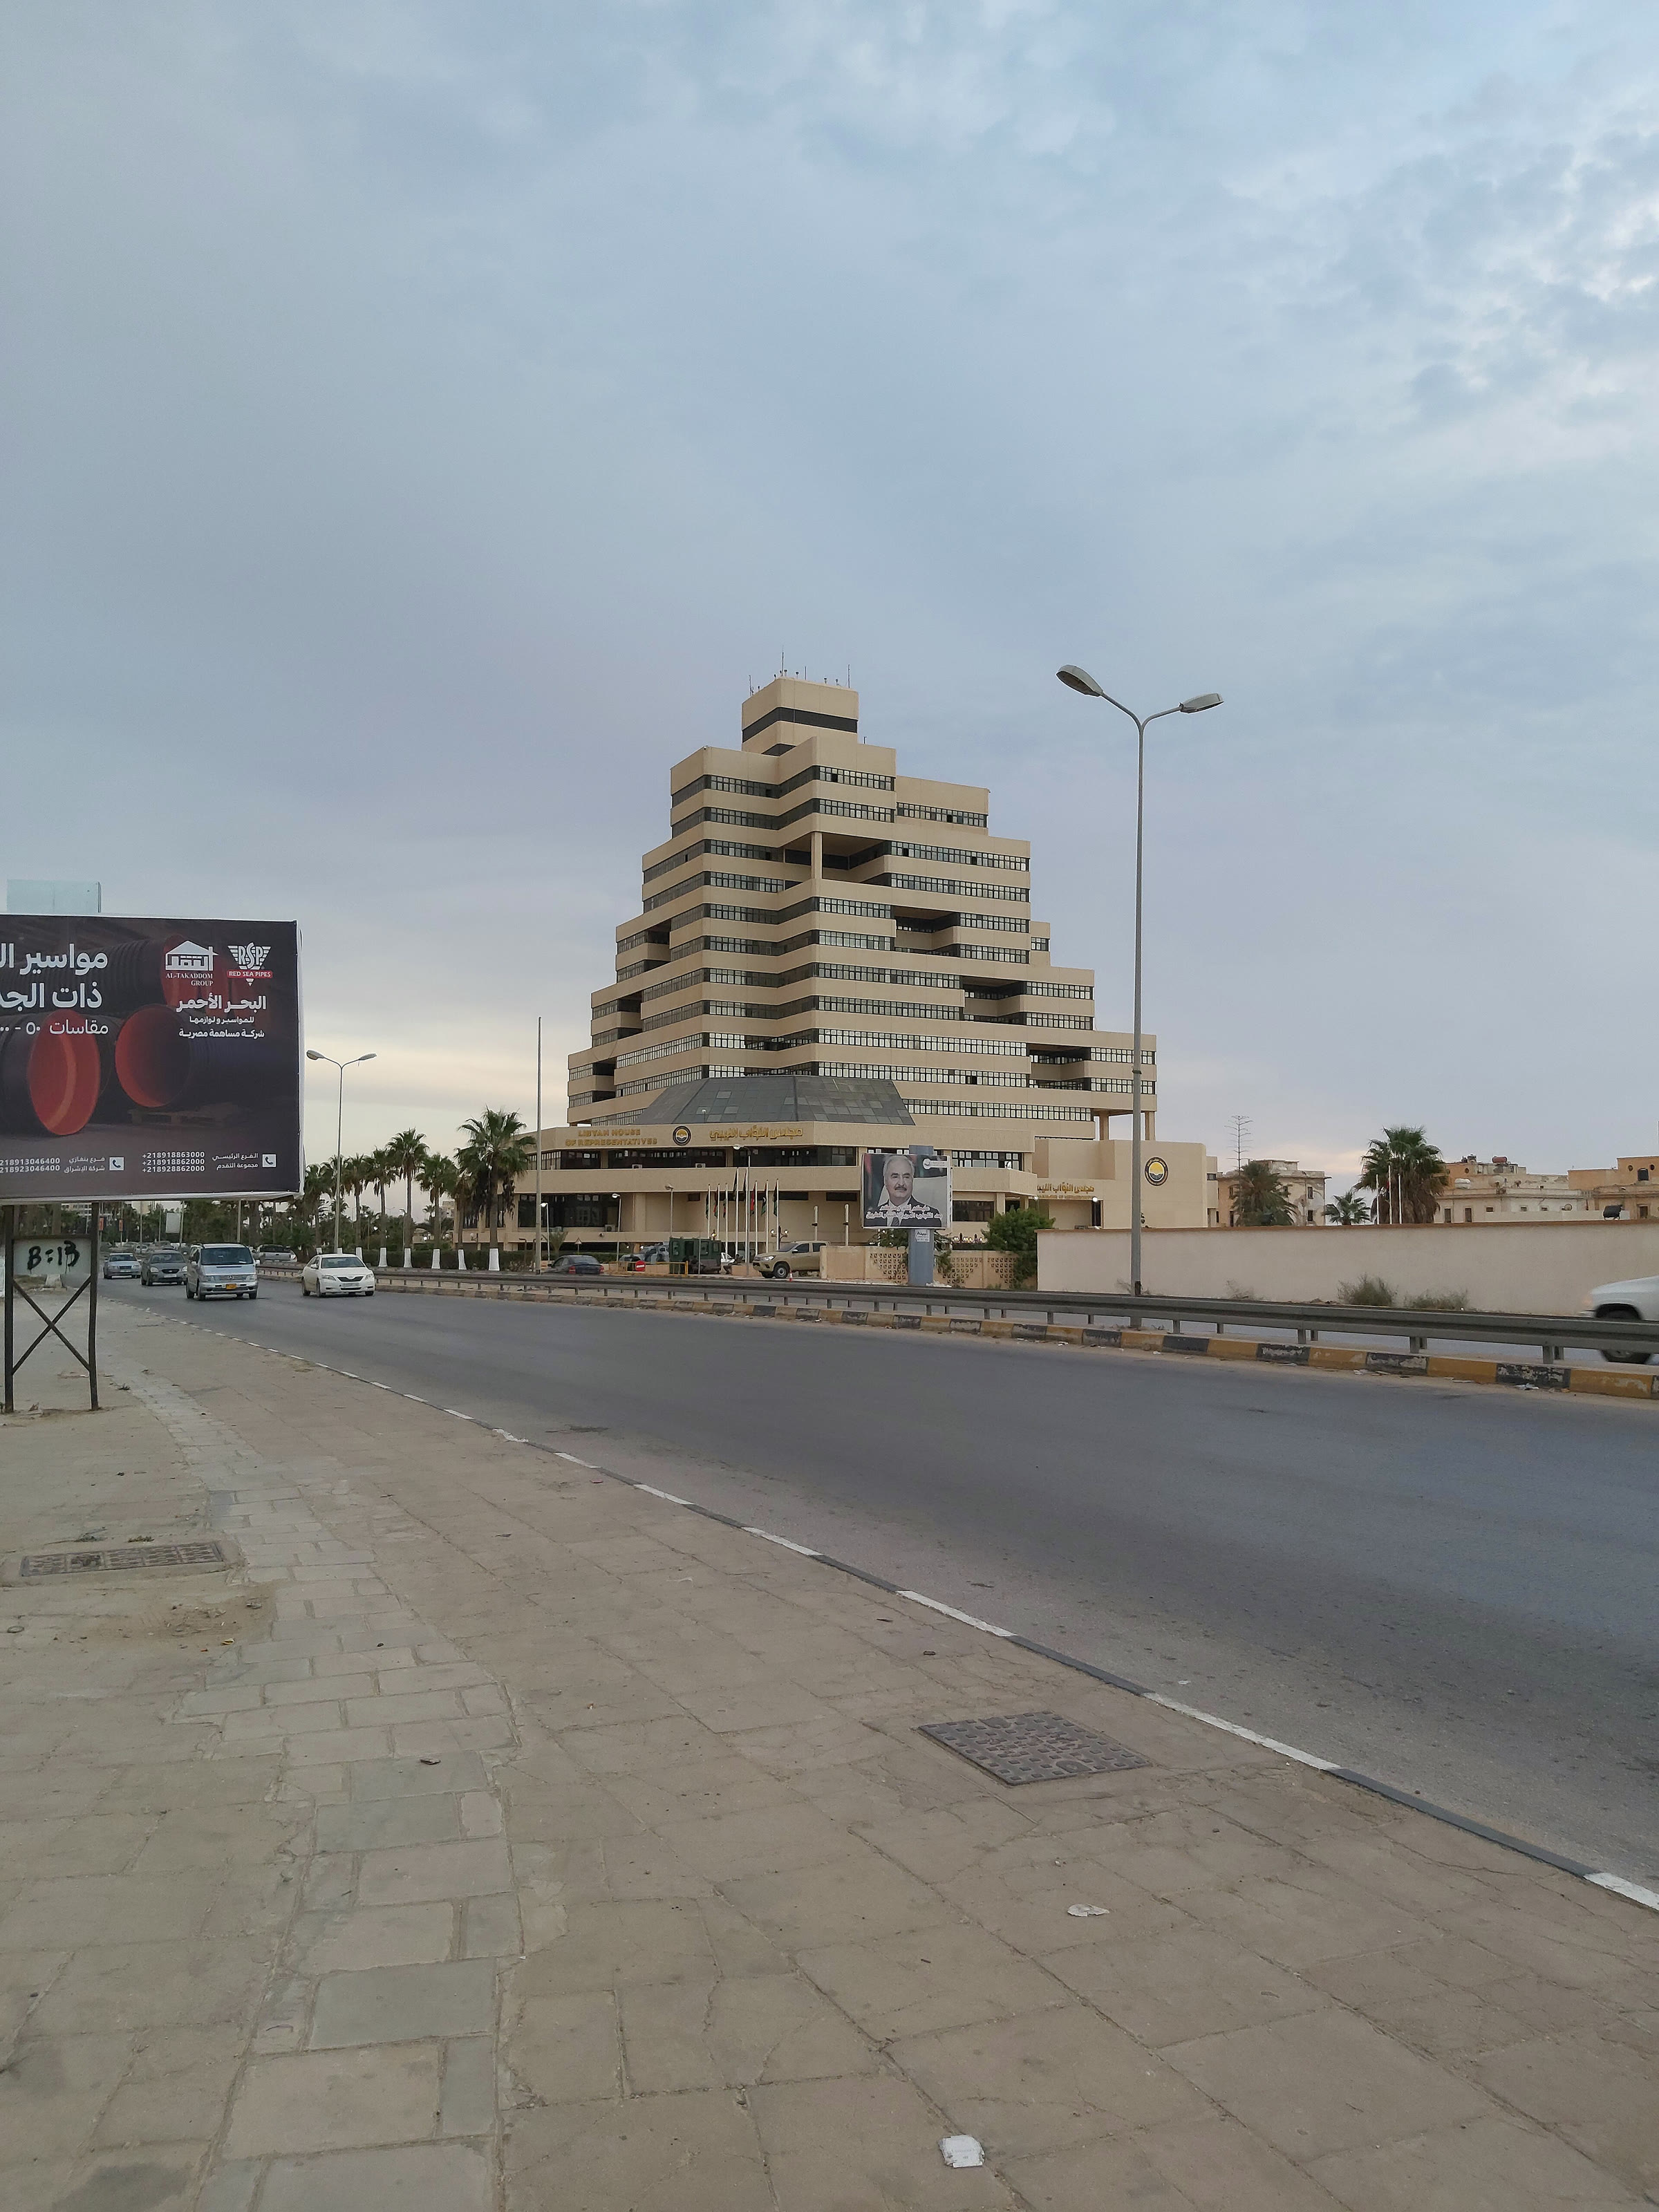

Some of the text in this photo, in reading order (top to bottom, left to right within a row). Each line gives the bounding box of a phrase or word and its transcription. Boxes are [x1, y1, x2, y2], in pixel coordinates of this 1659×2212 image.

[19, 943, 108, 975] مواسير
[238, 942, 263, 968] RSP
[0, 982, 102, 1011] ذات الج
[176, 993, 266, 1013] البحر الأحمر
[221, 1016, 254, 1024] للمواسير
[50, 1019, 109, 1035] مقاسات
[178, 1029, 265, 1039] شركة مساهمة مصرية
[578, 1128, 641, 1137] LIBYAN HOUSE
[709, 1128, 738, 1141] الليبي
[769, 1126, 804, 1140] مجلس
[578, 1138, 658, 1146] REPRESENTATIVES
[212, 1153, 241, 1161] الرئيسي
[1074, 1184, 1094, 1194] مجلس
